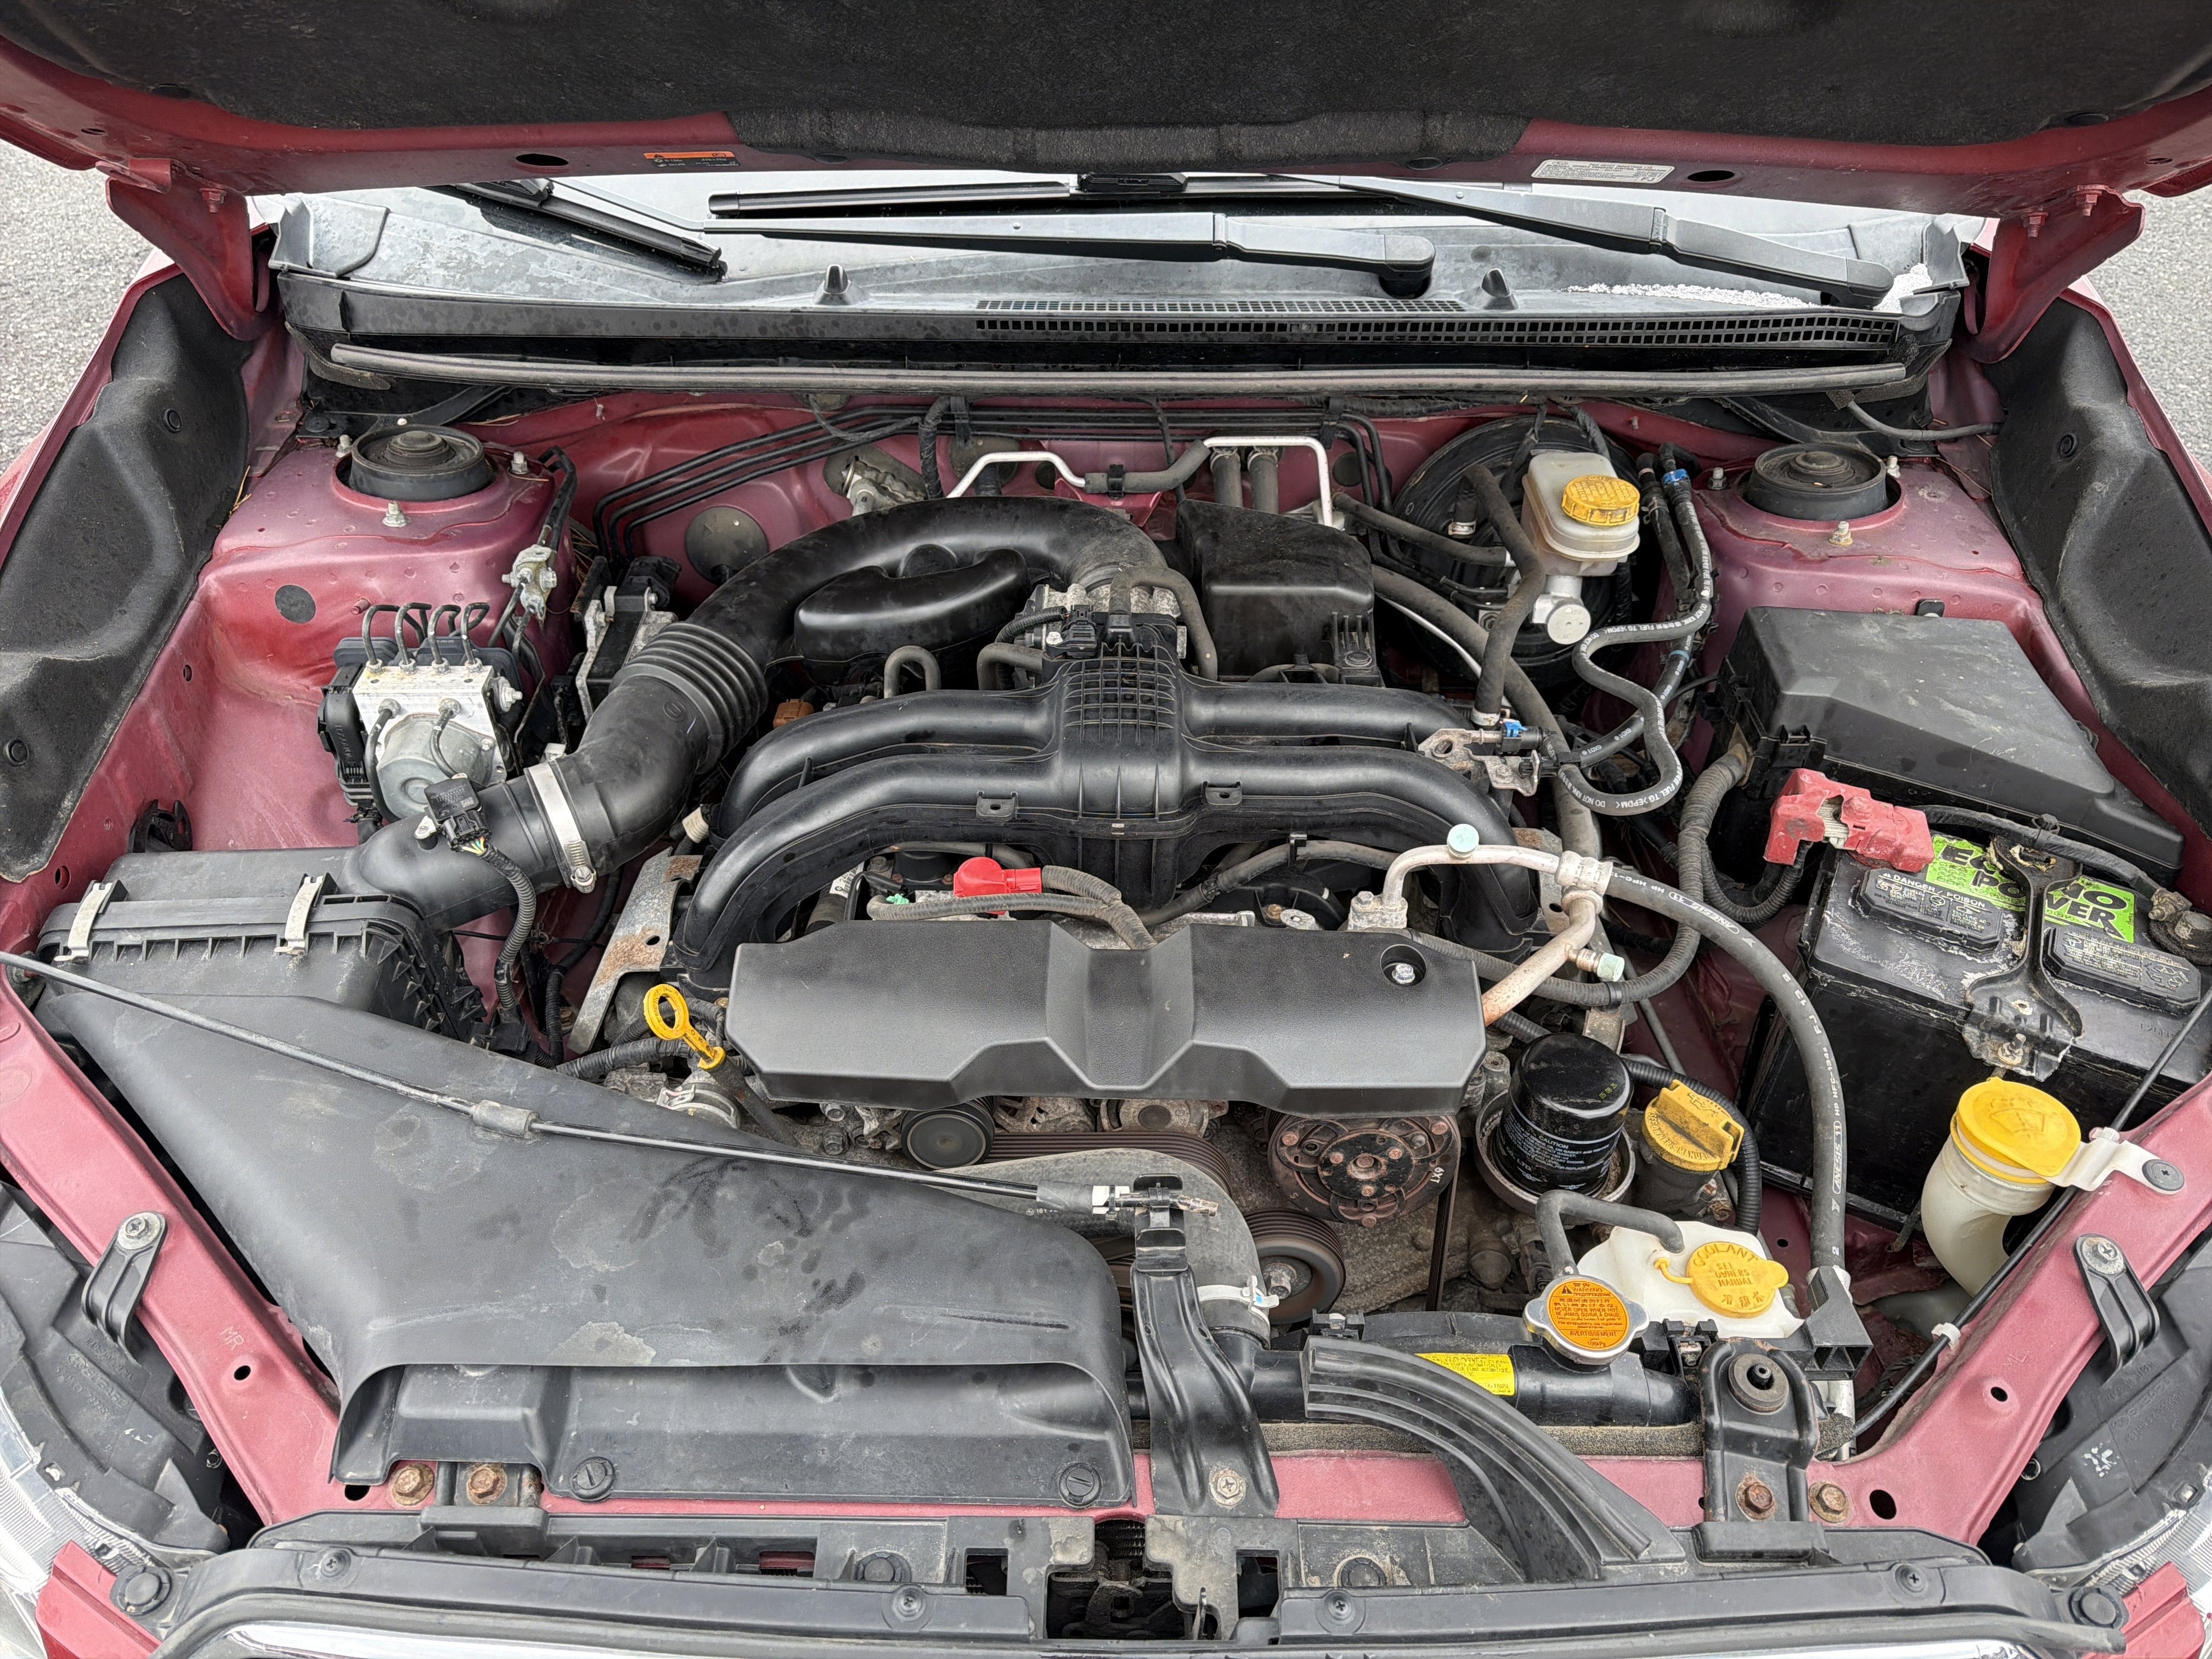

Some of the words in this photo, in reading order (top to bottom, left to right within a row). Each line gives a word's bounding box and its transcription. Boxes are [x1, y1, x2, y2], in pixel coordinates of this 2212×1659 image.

[1648, 793, 1662, 803] TG
[1659, 784, 1675, 798] FUEL
[1582, 795, 1594, 804] NOT
[1611, 871, 1647, 887] HFC-1
[1651, 885, 1665, 894] HP
[1893, 874, 1936, 893] DANGER
[1946, 891, 1986, 908] POISON
[1782, 971, 1791, 983] 2
[1794, 989, 1807, 1006] 13
[1834, 1102, 1840, 1116] HP
[1647, 1111, 1657, 1126] SEE
[1677, 1147, 1712, 1161] MANUAL
[1835, 1124, 1841, 1136] 11
[1538, 1135, 1569, 1149] CAUTION
[1693, 1243, 1759, 1267] COOLANT
[1832, 1245, 1840, 1256] 2
[1715, 1269, 1751, 1279] OWNERS
[1718, 1278, 1754, 1287] MANUAL
[219, 1325, 244, 1351] MR
